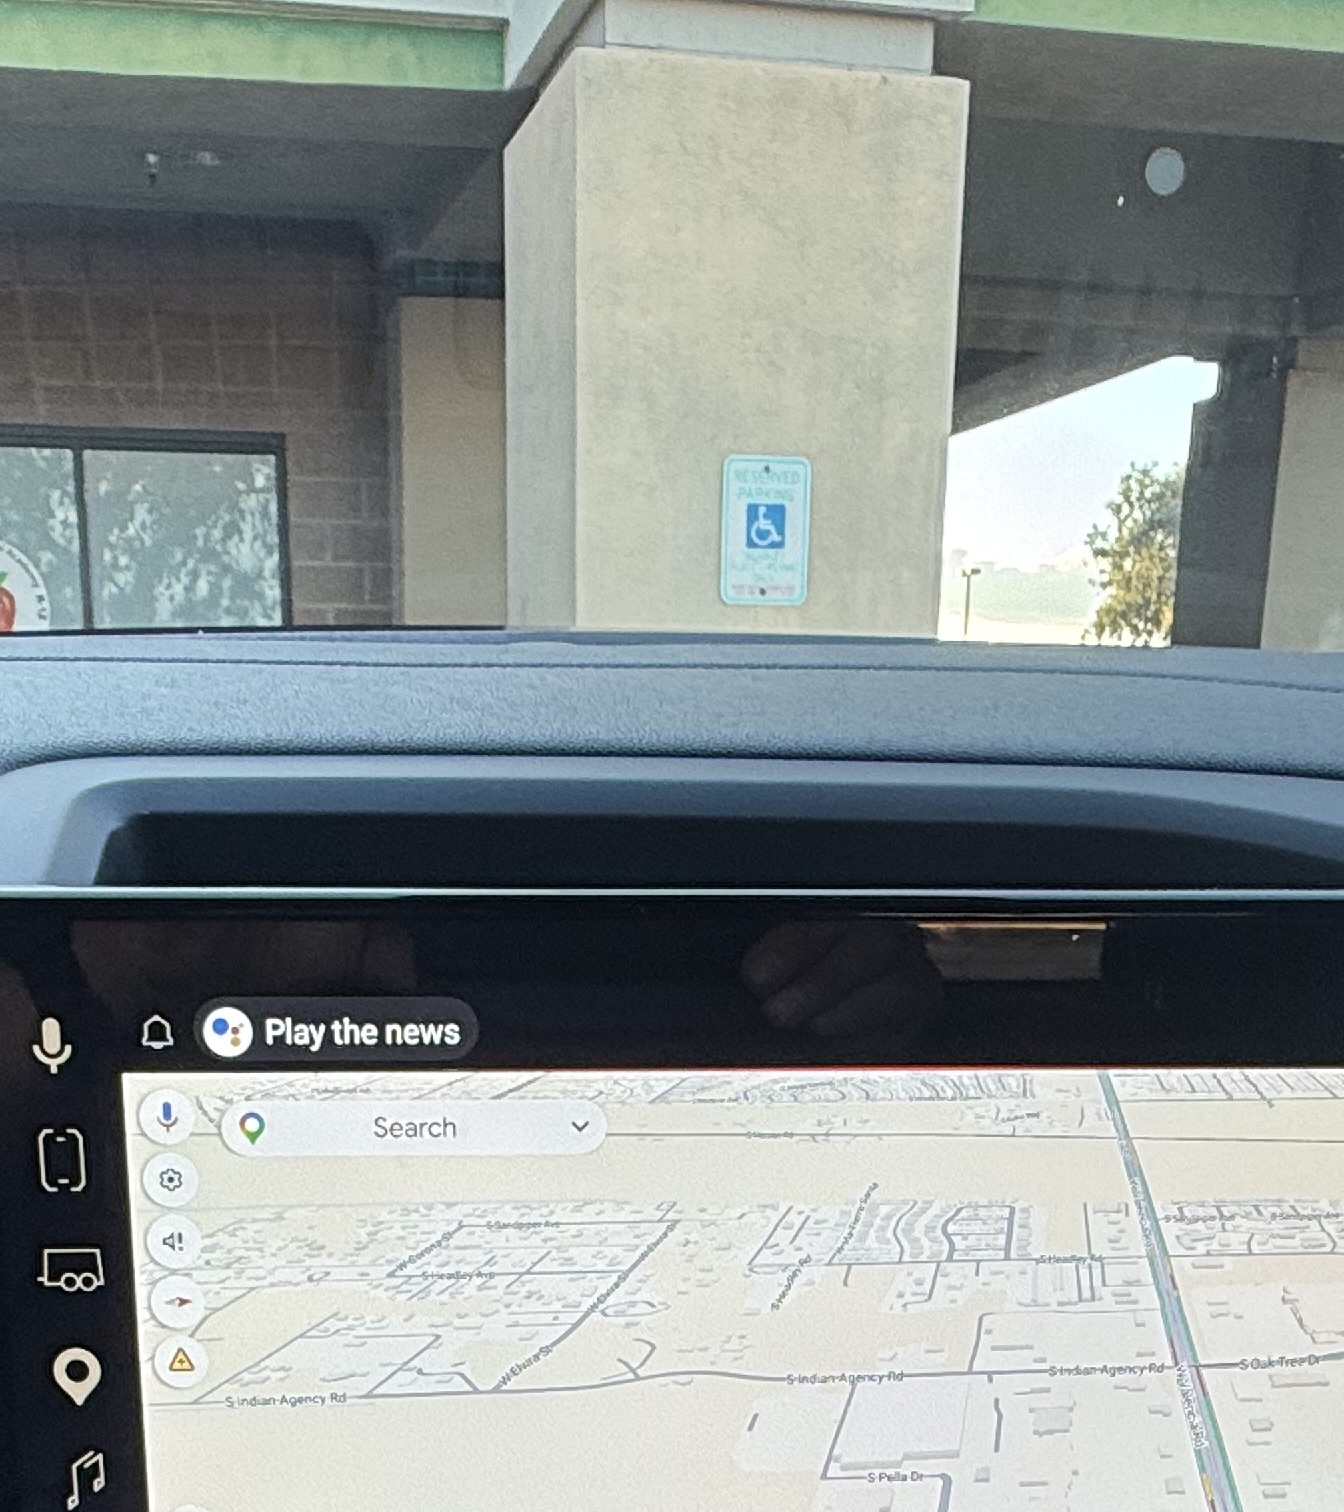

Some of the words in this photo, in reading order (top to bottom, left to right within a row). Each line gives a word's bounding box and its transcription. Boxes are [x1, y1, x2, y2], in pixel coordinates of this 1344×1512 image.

[265, 1017, 326, 1052] Play
[331, 1017, 379, 1046] the
[385, 1022, 461, 1046] news
[373, 1116, 457, 1139] Search
[1048, 1366, 1058, 1377] S
[1099, 1364, 1145, 1378] Agency
[1148, 1362, 1165, 1374] Rd
[1239, 1359, 1250, 1371] S
[1251, 1356, 1275, 1370] Oak
[1278, 1356, 1306, 1368] Tree
[1308, 1354, 1320, 1366] Dr
[786, 1374, 794, 1385] S
[798, 1373, 835, 1385] Indian
[838, 1372, 884, 1386] Agency
[887, 1370, 905, 1382] Rd
[225, 1396, 235, 1408] S
[237, 1396, 276, 1408] Indian
[279, 1394, 326, 1408] Agency
[330, 1392, 347, 1404] Rd
[867, 1472, 875, 1483] S
[910, 1471, 924, 1482] Dr
